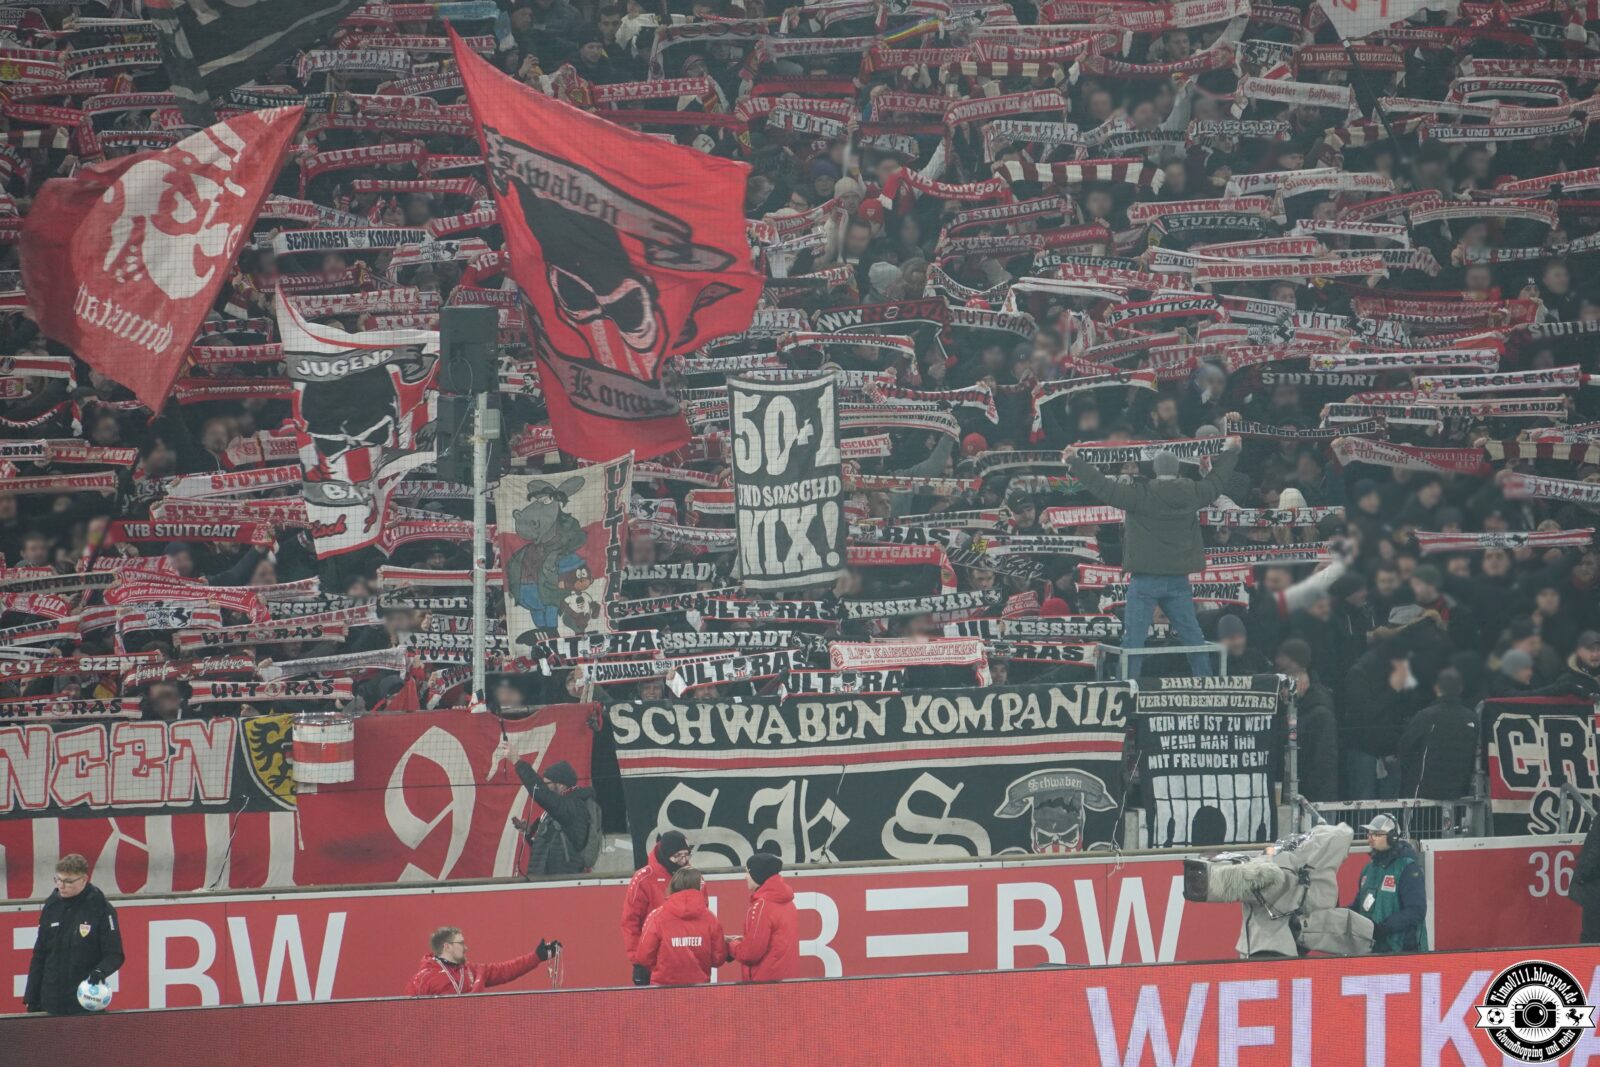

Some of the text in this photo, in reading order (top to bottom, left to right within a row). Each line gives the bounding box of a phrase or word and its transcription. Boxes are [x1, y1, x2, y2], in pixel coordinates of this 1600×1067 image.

[1429, 127, 1463, 138] STOLZ
[1466, 127, 1491, 138] UND
[1169, 216, 1262, 233] STUTTGAR
[287, 230, 348, 250] SCHWABEN
[1527, 324, 1600, 340] STUTTG
[296, 349, 394, 378] JUGEND
[124, 525, 241, 545] VfB STUTTGART
[847, 547, 934, 564] TUTTGART
[1213, 552, 1318, 572] HEISST KAMPFEN!
[845, 591, 984, 619] KESSELSTADT
[663, 632, 792, 651] ESSELSTADT
[1161, 675, 1253, 691] EHRE ALLEN
[1139, 693, 1275, 711] VERSTORBENEN ULTRAS
[610, 683, 1130, 746] SCHWABEN KOMPANIE
[1149, 714, 1273, 733] KEIN WEG IST ZU WEIT
[1160, 735, 1196, 751] WENN
[1200, 736, 1229, 750] MAN
[1148, 755, 1170, 770] MIT
[1173, 753, 1238, 769] FREUNDEN
[671, 936, 703, 948] VOLUNTEER
